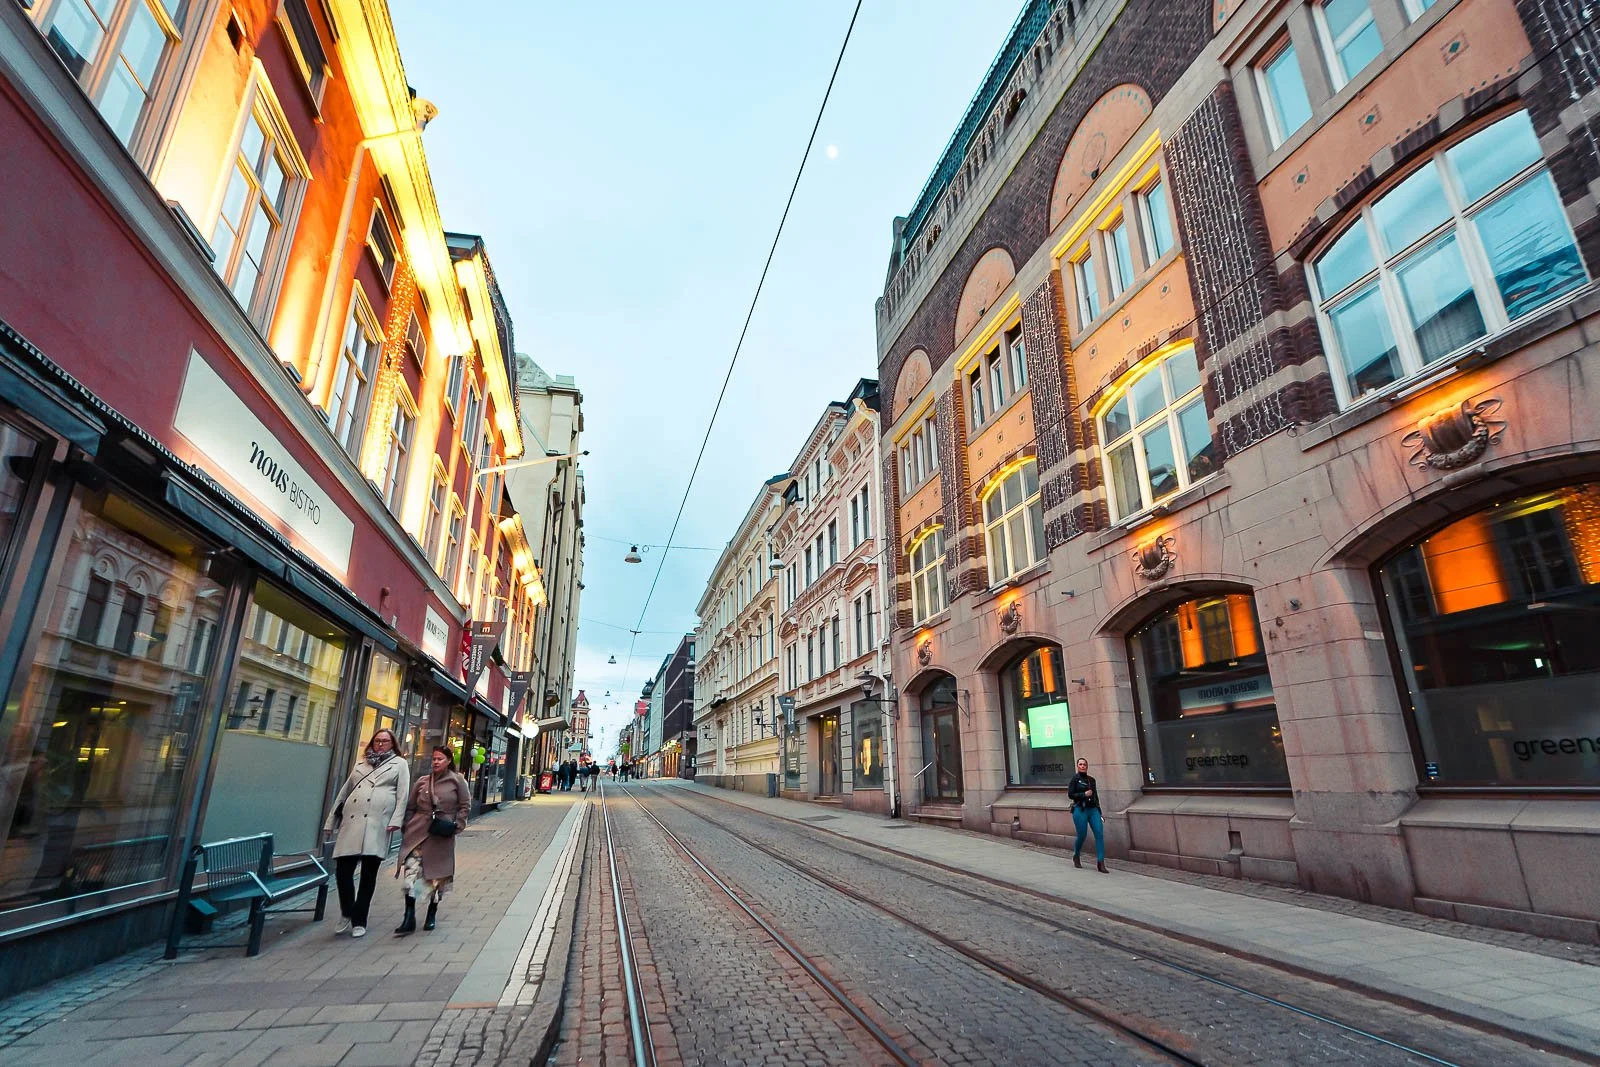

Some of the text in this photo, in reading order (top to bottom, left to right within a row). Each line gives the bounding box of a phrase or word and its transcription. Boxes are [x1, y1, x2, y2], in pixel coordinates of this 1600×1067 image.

[249, 441, 321, 525] nous BISTRO
[1185, 753, 1248, 771] greenstep
